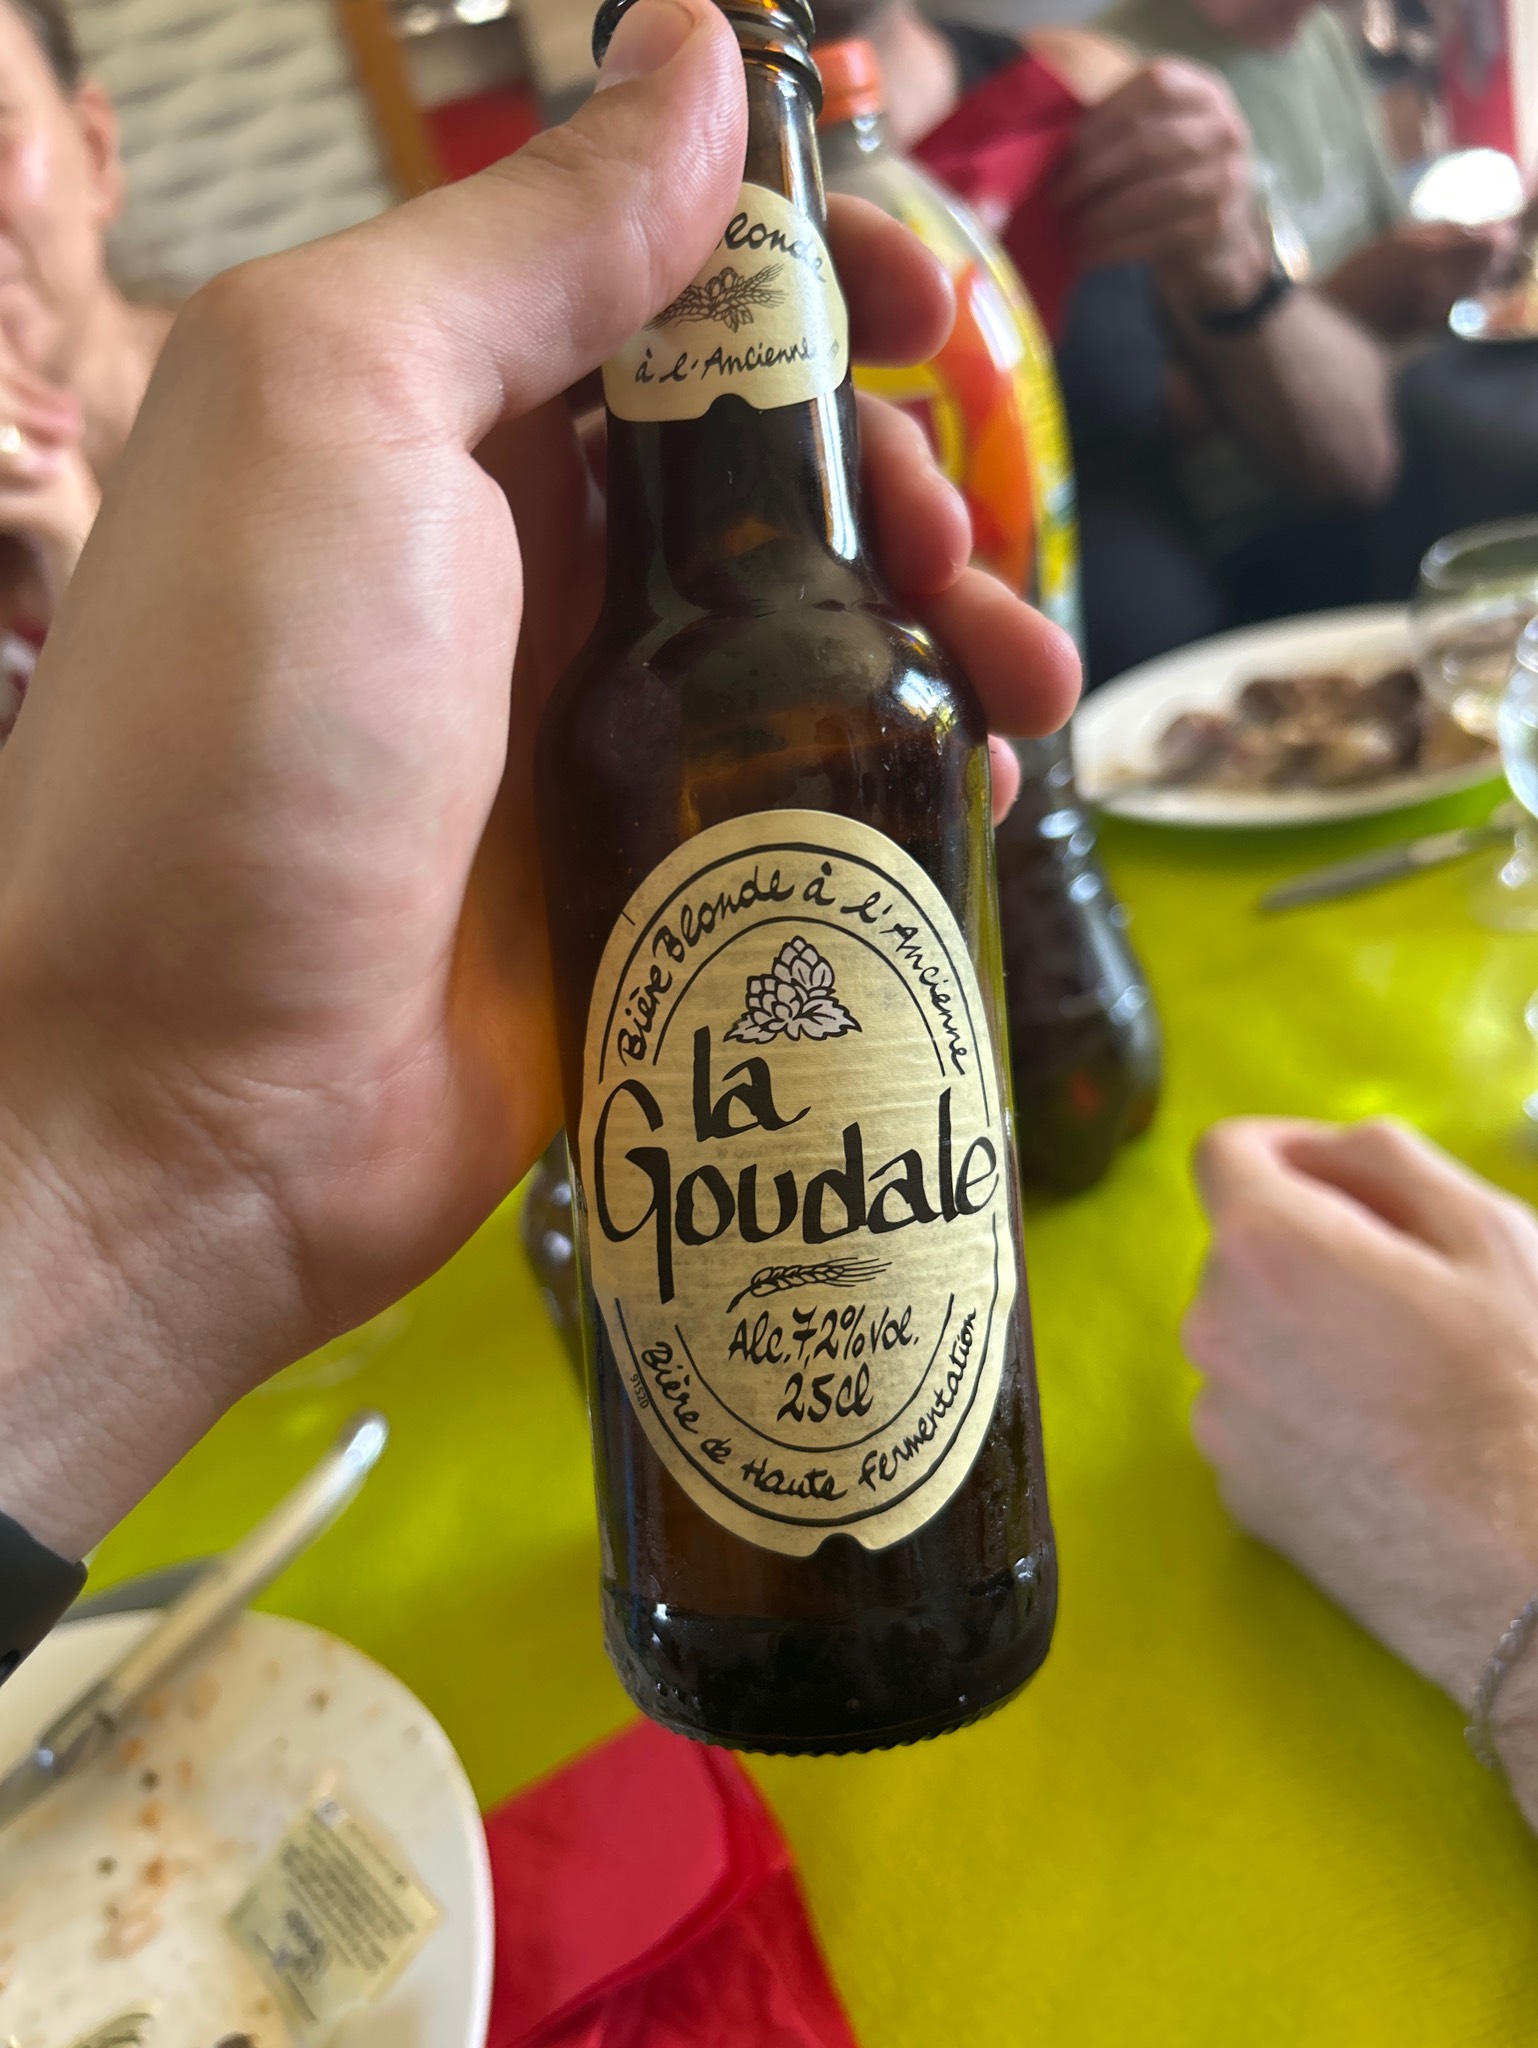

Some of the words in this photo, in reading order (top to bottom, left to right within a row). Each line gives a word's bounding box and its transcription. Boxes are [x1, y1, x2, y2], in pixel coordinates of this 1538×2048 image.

[714, 211, 826, 283] londe
[634, 348, 655, 384] à
[618, 965, 673, 1067] Bière
[652, 866, 795, 963] Blonde
[803, 861, 836, 906] à
[840, 891, 968, 1076] l'Ancienne
[693, 1026, 811, 1142] la
[593, 1079, 999, 1304] Goudale
[642, 1341, 699, 1434] Bière
[700, 1436, 732, 1465] de
[740, 1457, 847, 1501] Haute
